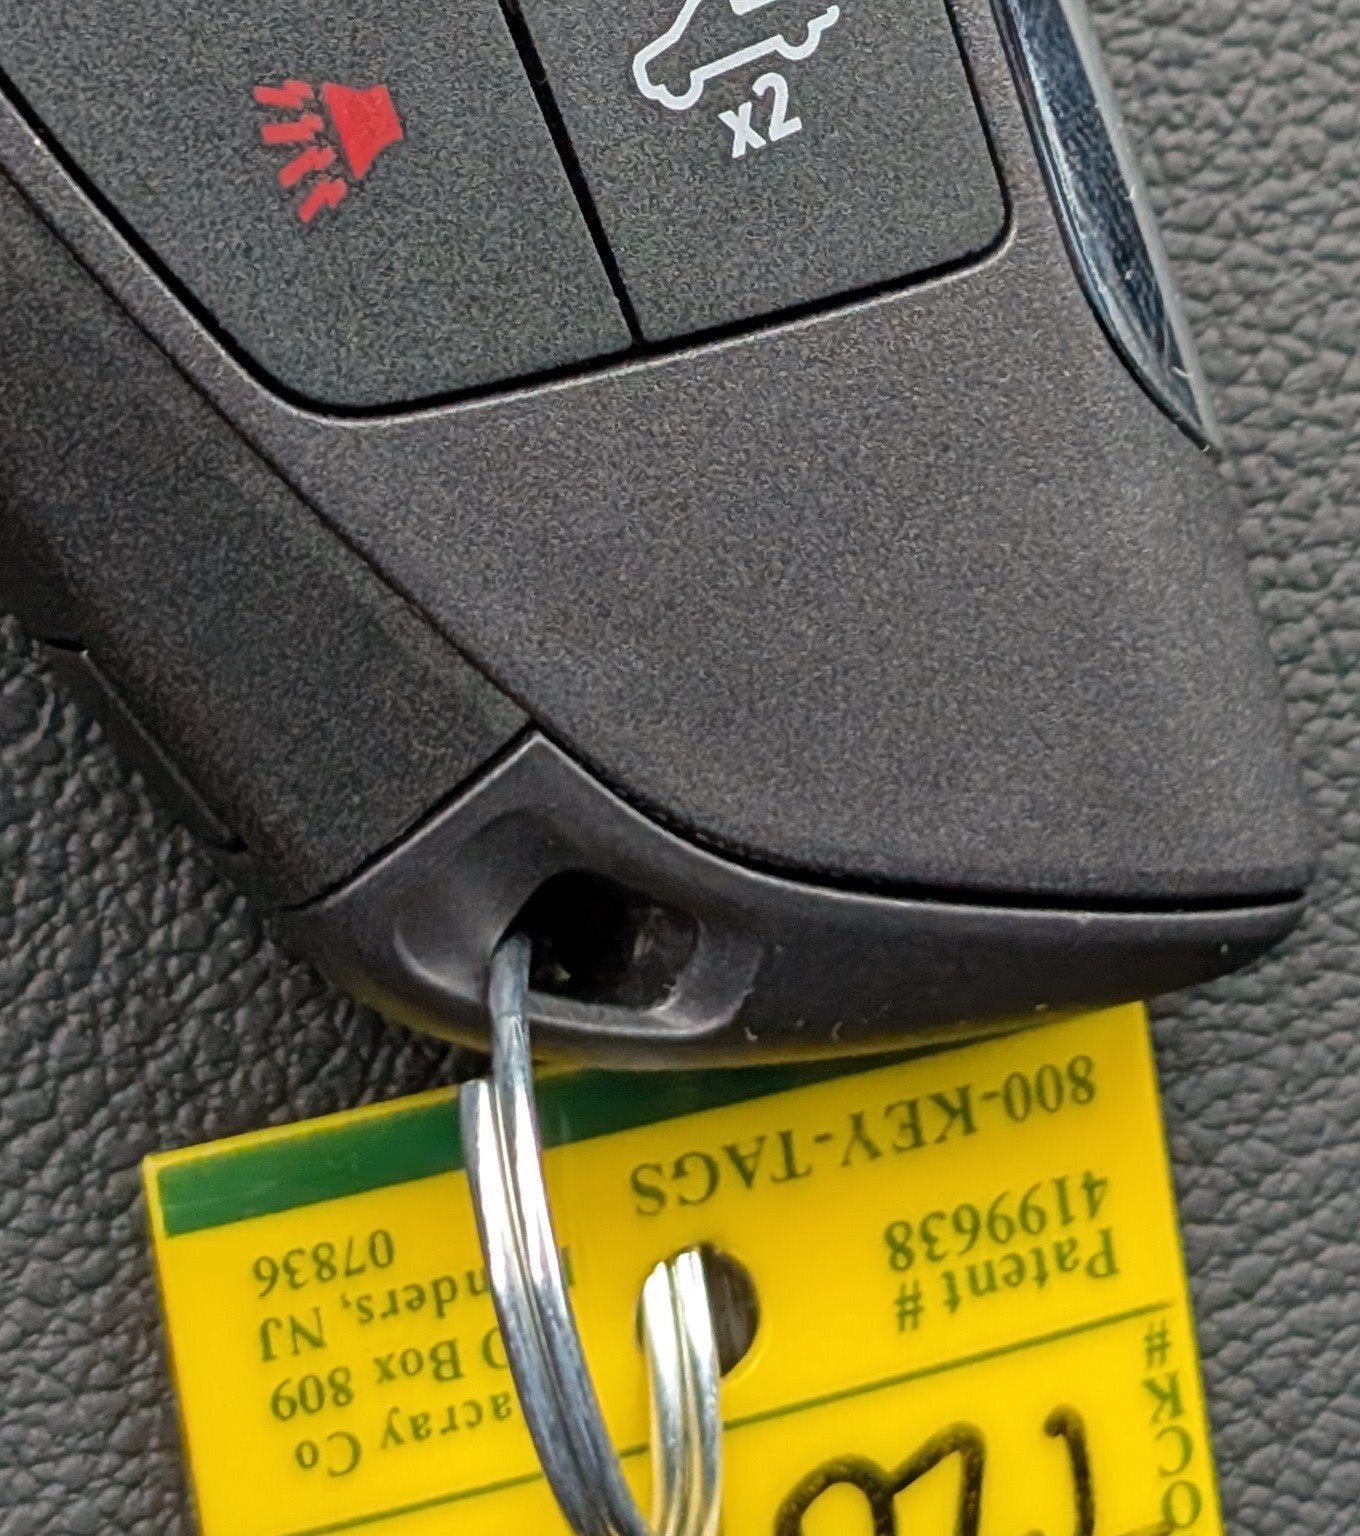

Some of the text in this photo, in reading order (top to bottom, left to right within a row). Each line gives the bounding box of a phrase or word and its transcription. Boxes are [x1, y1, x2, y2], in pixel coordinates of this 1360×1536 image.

[717, 71, 803, 158] x2
[629, 1054, 1097, 1217] 800-KEY-TAGS
[251, 1228, 396, 1298] 07836
[883, 1169, 1109, 1272] 4199638
[893, 1226, 1119, 1333] Patent #
[257, 1306, 329, 1363] NJ
[372, 1336, 464, 1384] Box
[268, 1365, 355, 1423] 809
[293, 1389, 513, 1479] acray Co
